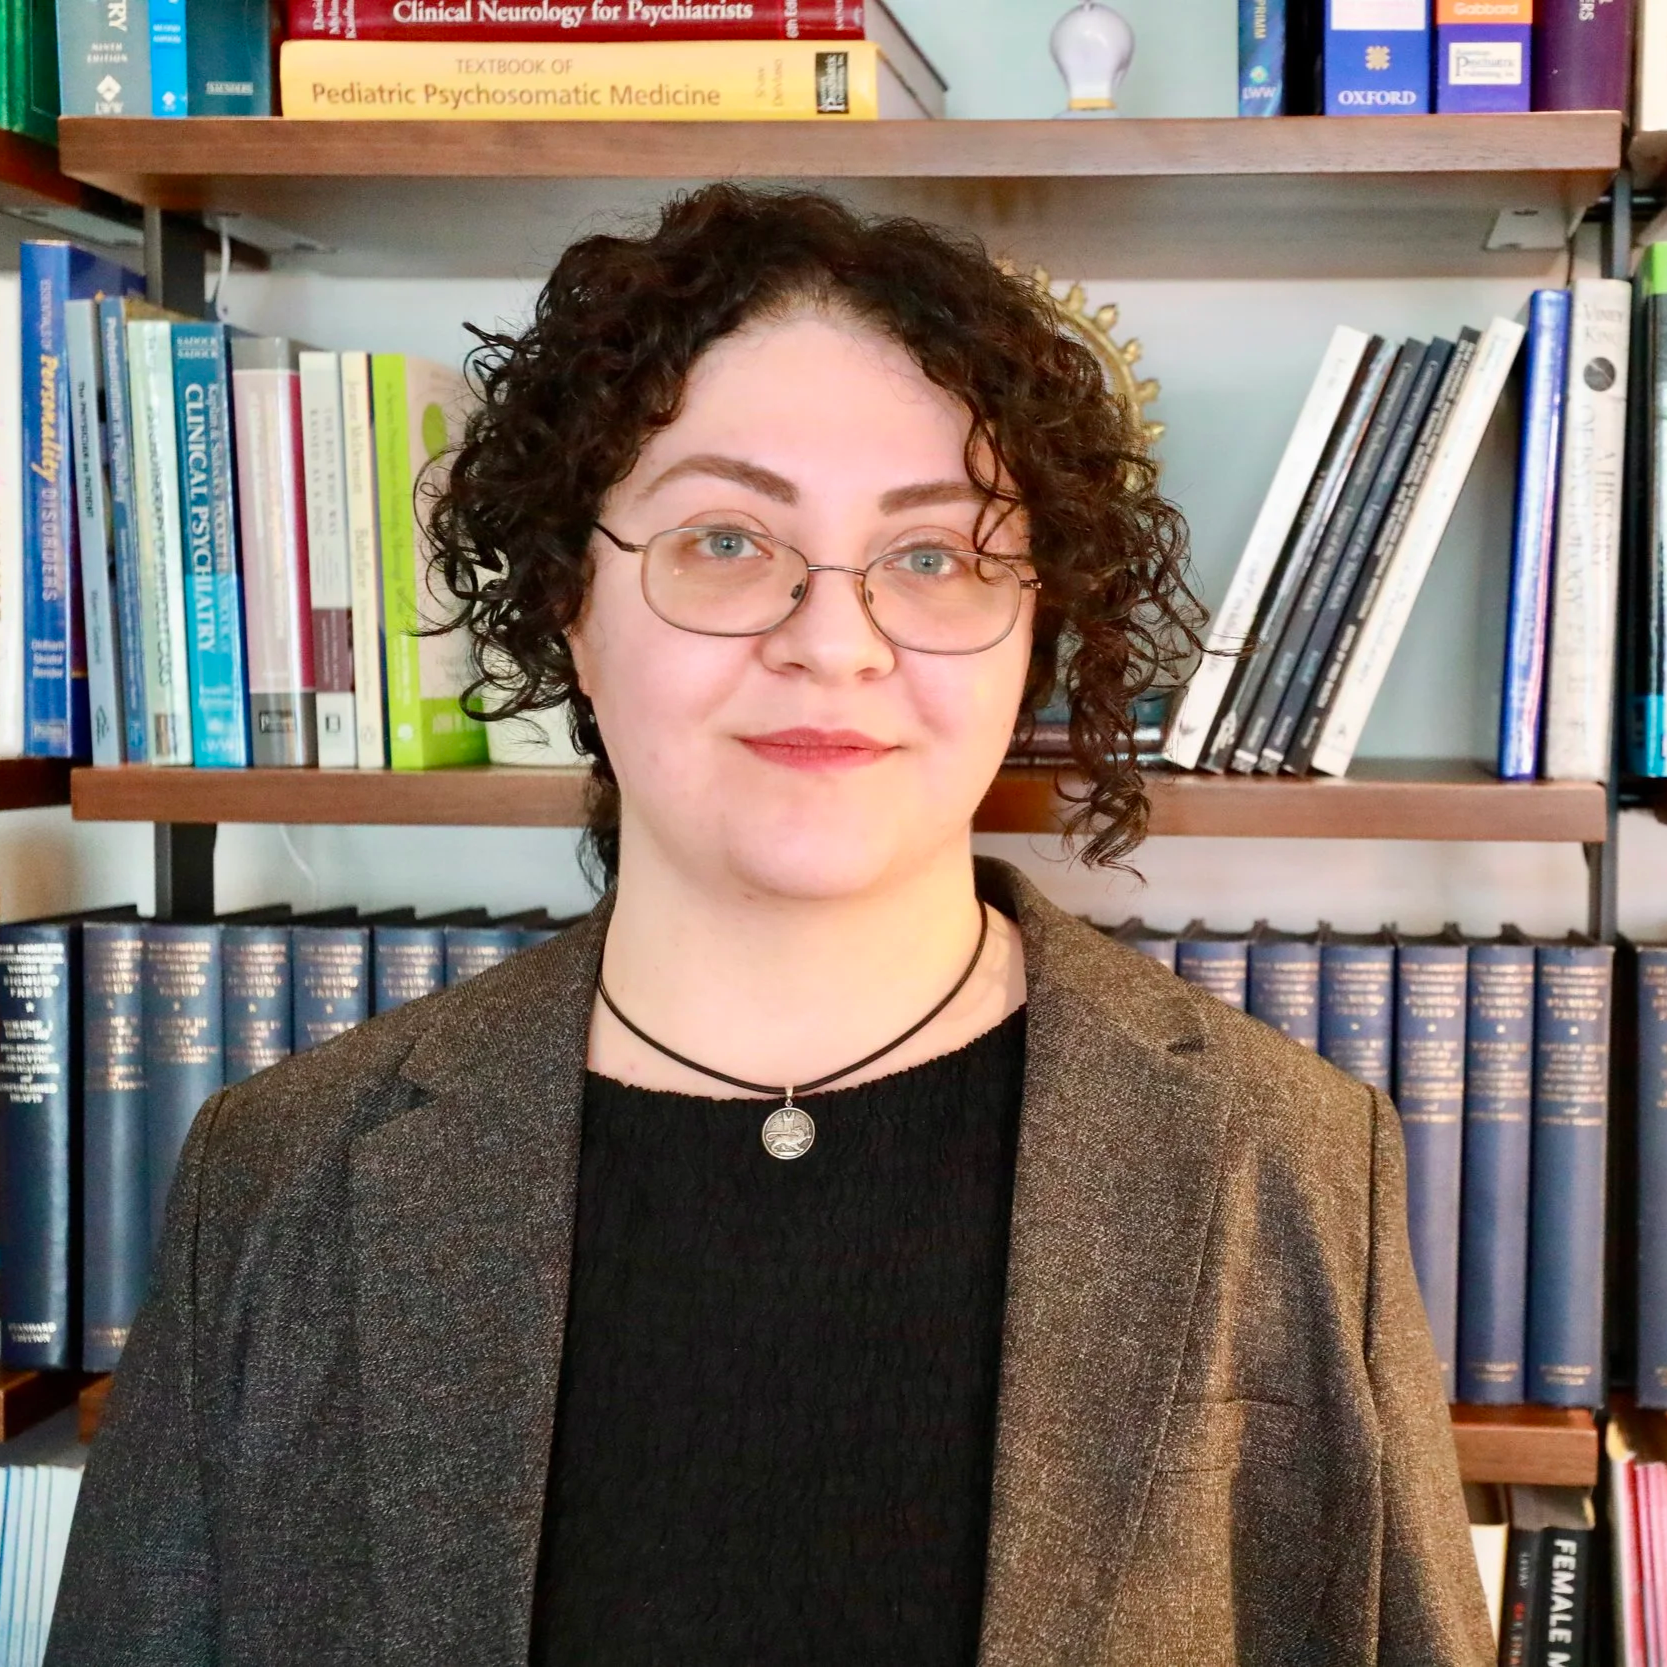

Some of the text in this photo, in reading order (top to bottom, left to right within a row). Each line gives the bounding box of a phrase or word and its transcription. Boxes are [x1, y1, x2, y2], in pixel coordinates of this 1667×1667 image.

[108, 0, 127, 31] RY
[393, 0, 752, 28] Clinical Neurology for Psychiatrists
[1454, 2, 1518, 15] Gabbard
[456, 58, 573, 74] TEXTBOOK OF
[312, 83, 720, 109] Pediatric Psychosomatic Medicine
[1243, 87, 1276, 99] LWW
[1338, 90, 1417, 106] OXFORD
[32, 354, 65, 484] Personality
[185, 383, 218, 652] CLINICAL PSYCHIATRY
[42, 487, 58, 603] DISORDERS
[1549, 1539, 1578, 1644] FEMALE
